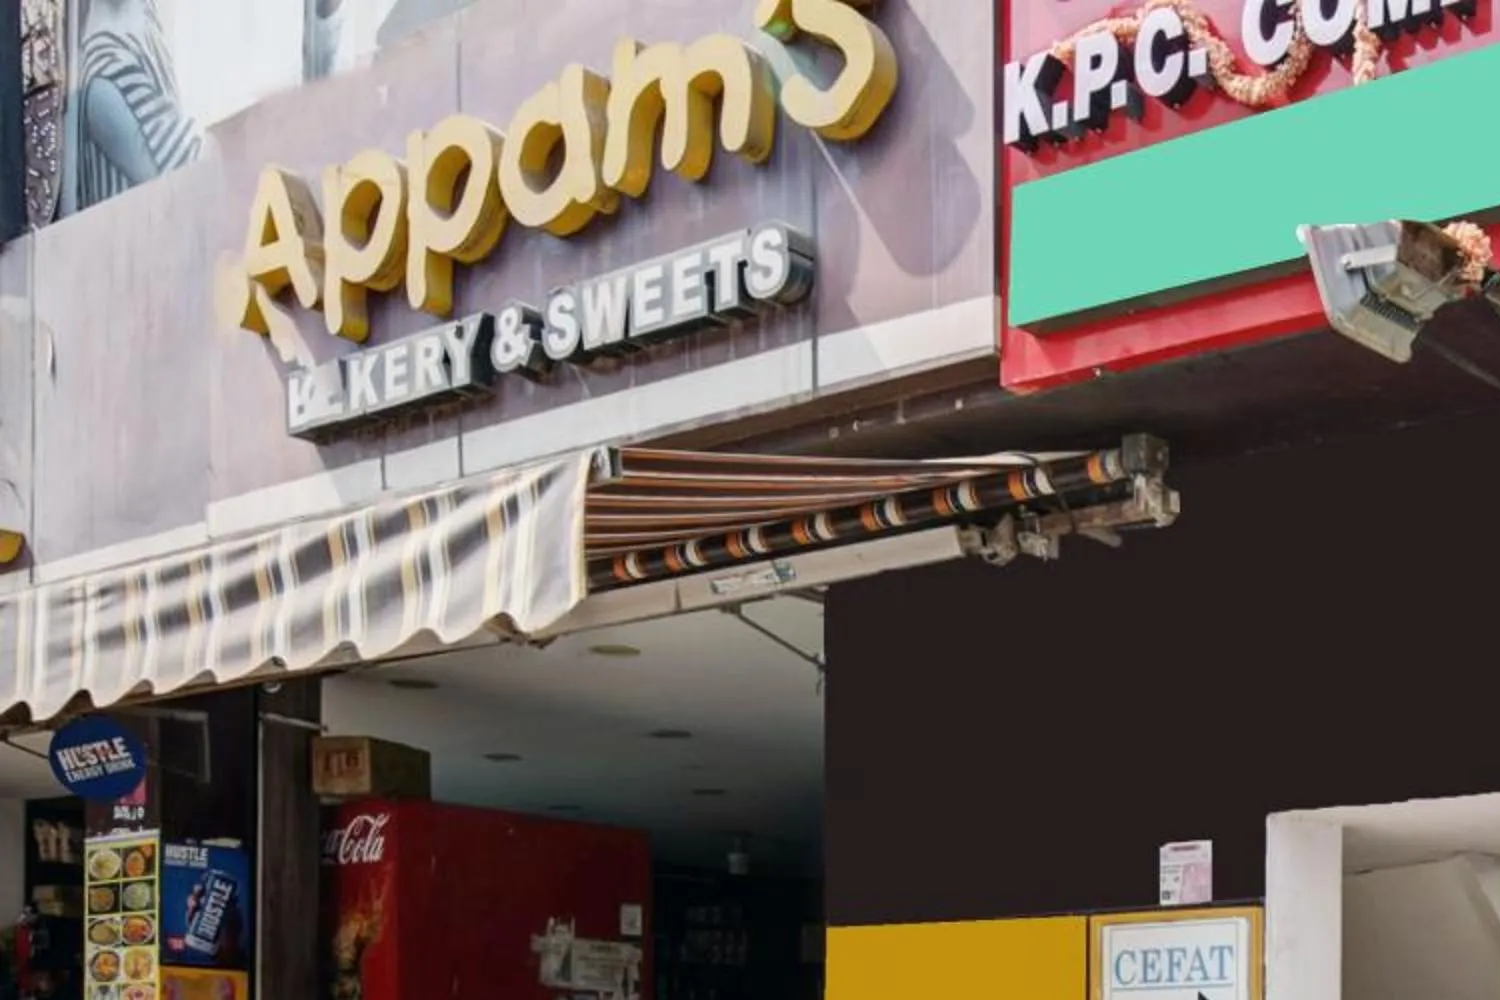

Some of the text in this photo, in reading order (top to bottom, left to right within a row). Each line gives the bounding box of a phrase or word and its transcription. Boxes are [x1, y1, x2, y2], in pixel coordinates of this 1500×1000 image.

[1003, 7, 1208, 145] K.P.C.
[491, 303, 541, 371] &
[543, 223, 788, 361] SWEETS
[1114, 944, 1233, 986] CEFAT
